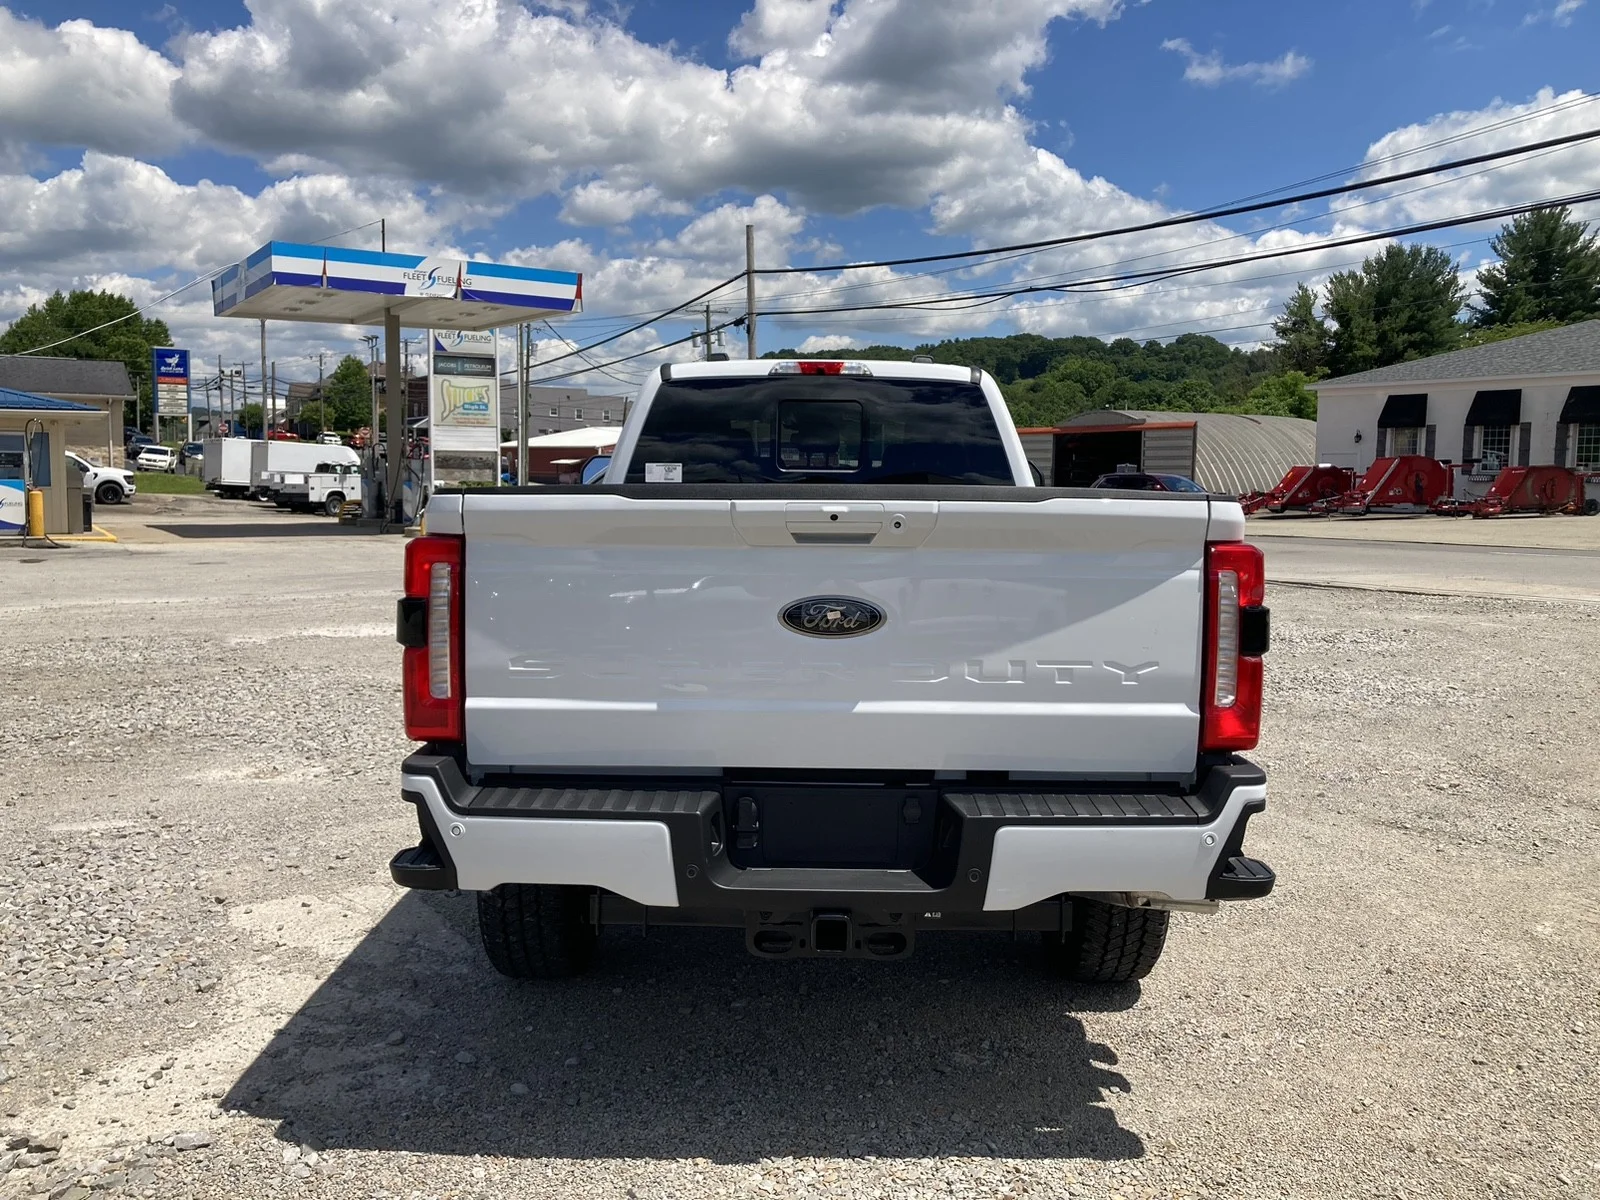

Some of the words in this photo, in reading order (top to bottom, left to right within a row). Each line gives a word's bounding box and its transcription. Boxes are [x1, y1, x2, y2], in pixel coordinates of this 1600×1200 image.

[403, 271, 427, 281] FLEET
[437, 332, 456, 340] FLEET
[465, 333, 492, 342] FUELING
[803, 604, 861, 629] Ford
[890, 659, 1160, 685] DUTY
